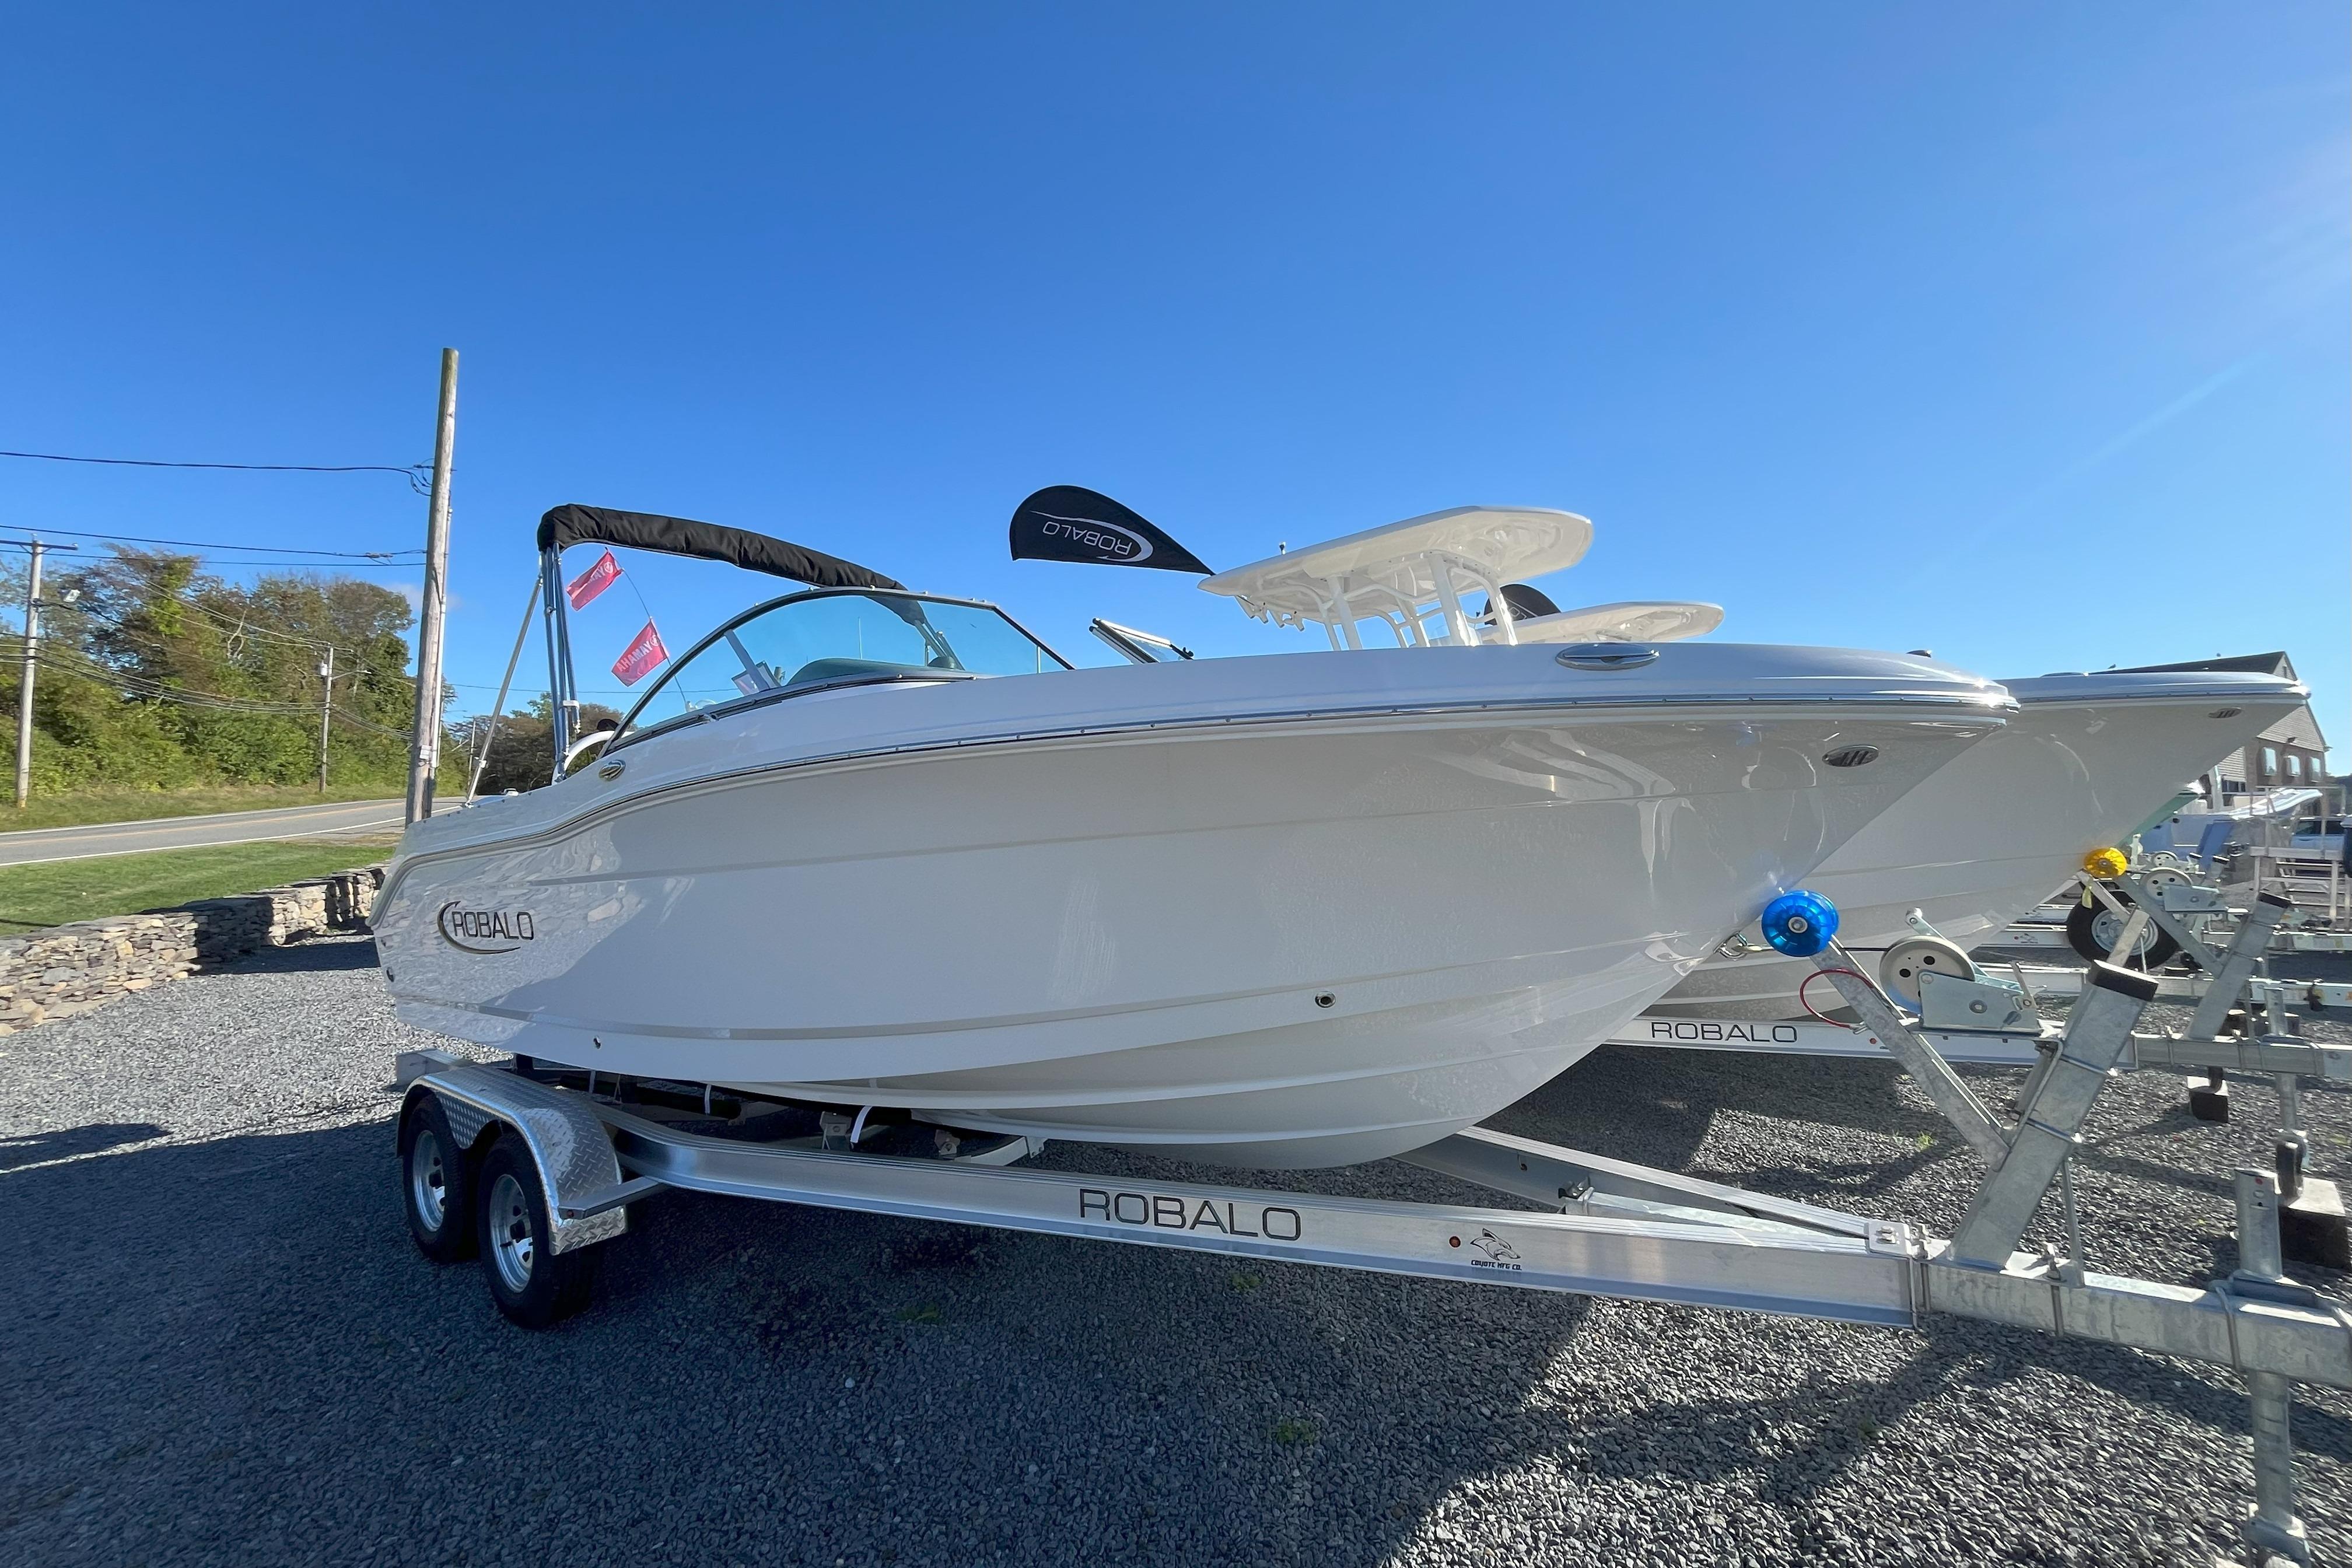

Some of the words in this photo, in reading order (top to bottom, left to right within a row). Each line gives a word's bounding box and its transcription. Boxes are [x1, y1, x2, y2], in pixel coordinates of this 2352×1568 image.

[1043, 522, 1133, 555] ROBALO
[452, 911, 534, 940] ROBALO
[1651, 1022, 1797, 1042] ROBALO
[1080, 1188, 1301, 1241] ROBALO
